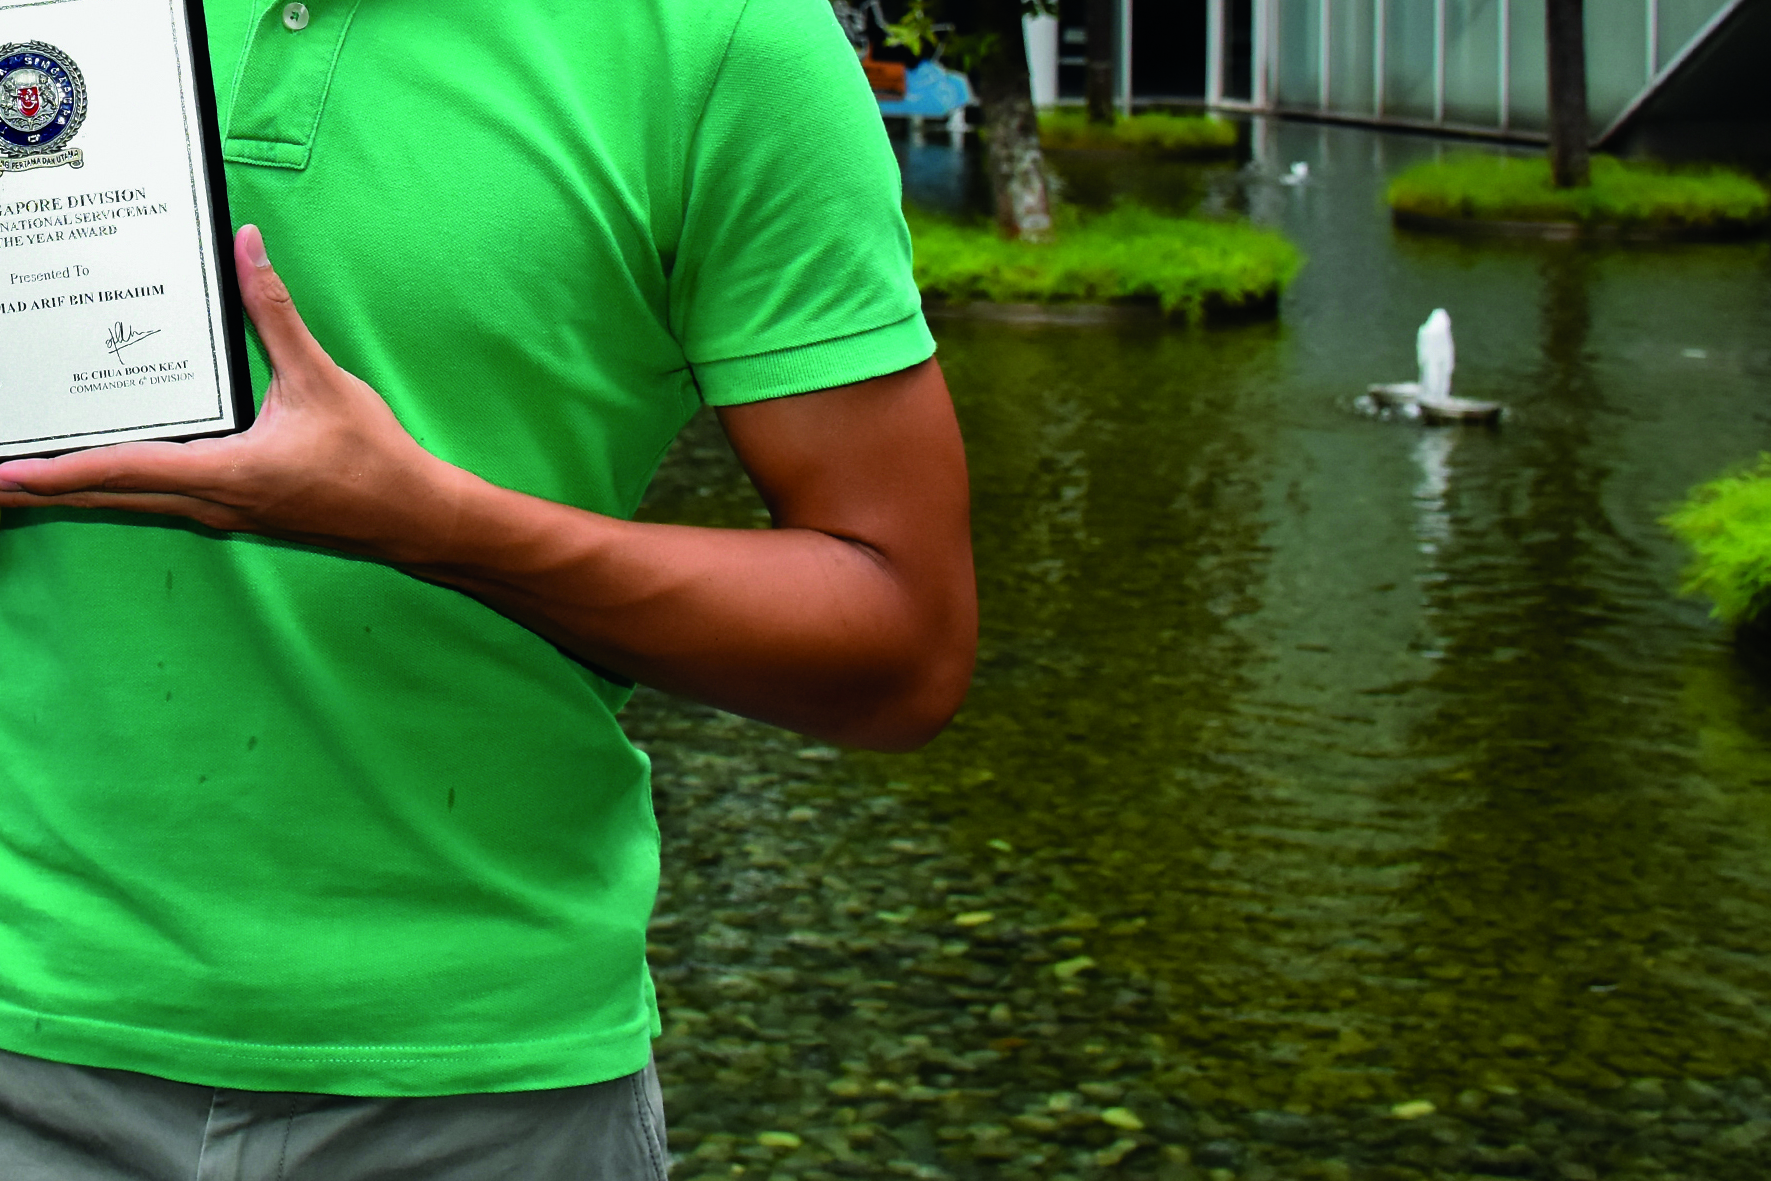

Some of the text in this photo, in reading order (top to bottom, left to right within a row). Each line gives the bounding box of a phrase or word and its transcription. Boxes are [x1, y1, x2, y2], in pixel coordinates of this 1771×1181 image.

[67, 187, 146, 209] DIVISION
[0, 214, 73, 233] NATIONAL
[74, 203, 168, 224] SERVICEMAN
[26, 230, 65, 245] YEAR
[68, 224, 118, 240] AWARD
[10, 265, 90, 285] Presented To
[30, 295, 66, 311] ARIF
[69, 292, 94, 306] BIN
[98, 284, 165, 303] IBRAHIM
[72, 360, 189, 382] BG CHUA BOON KEAT
[69, 379, 136, 395] COMMANDER
[150, 372, 195, 385] DIVISION
